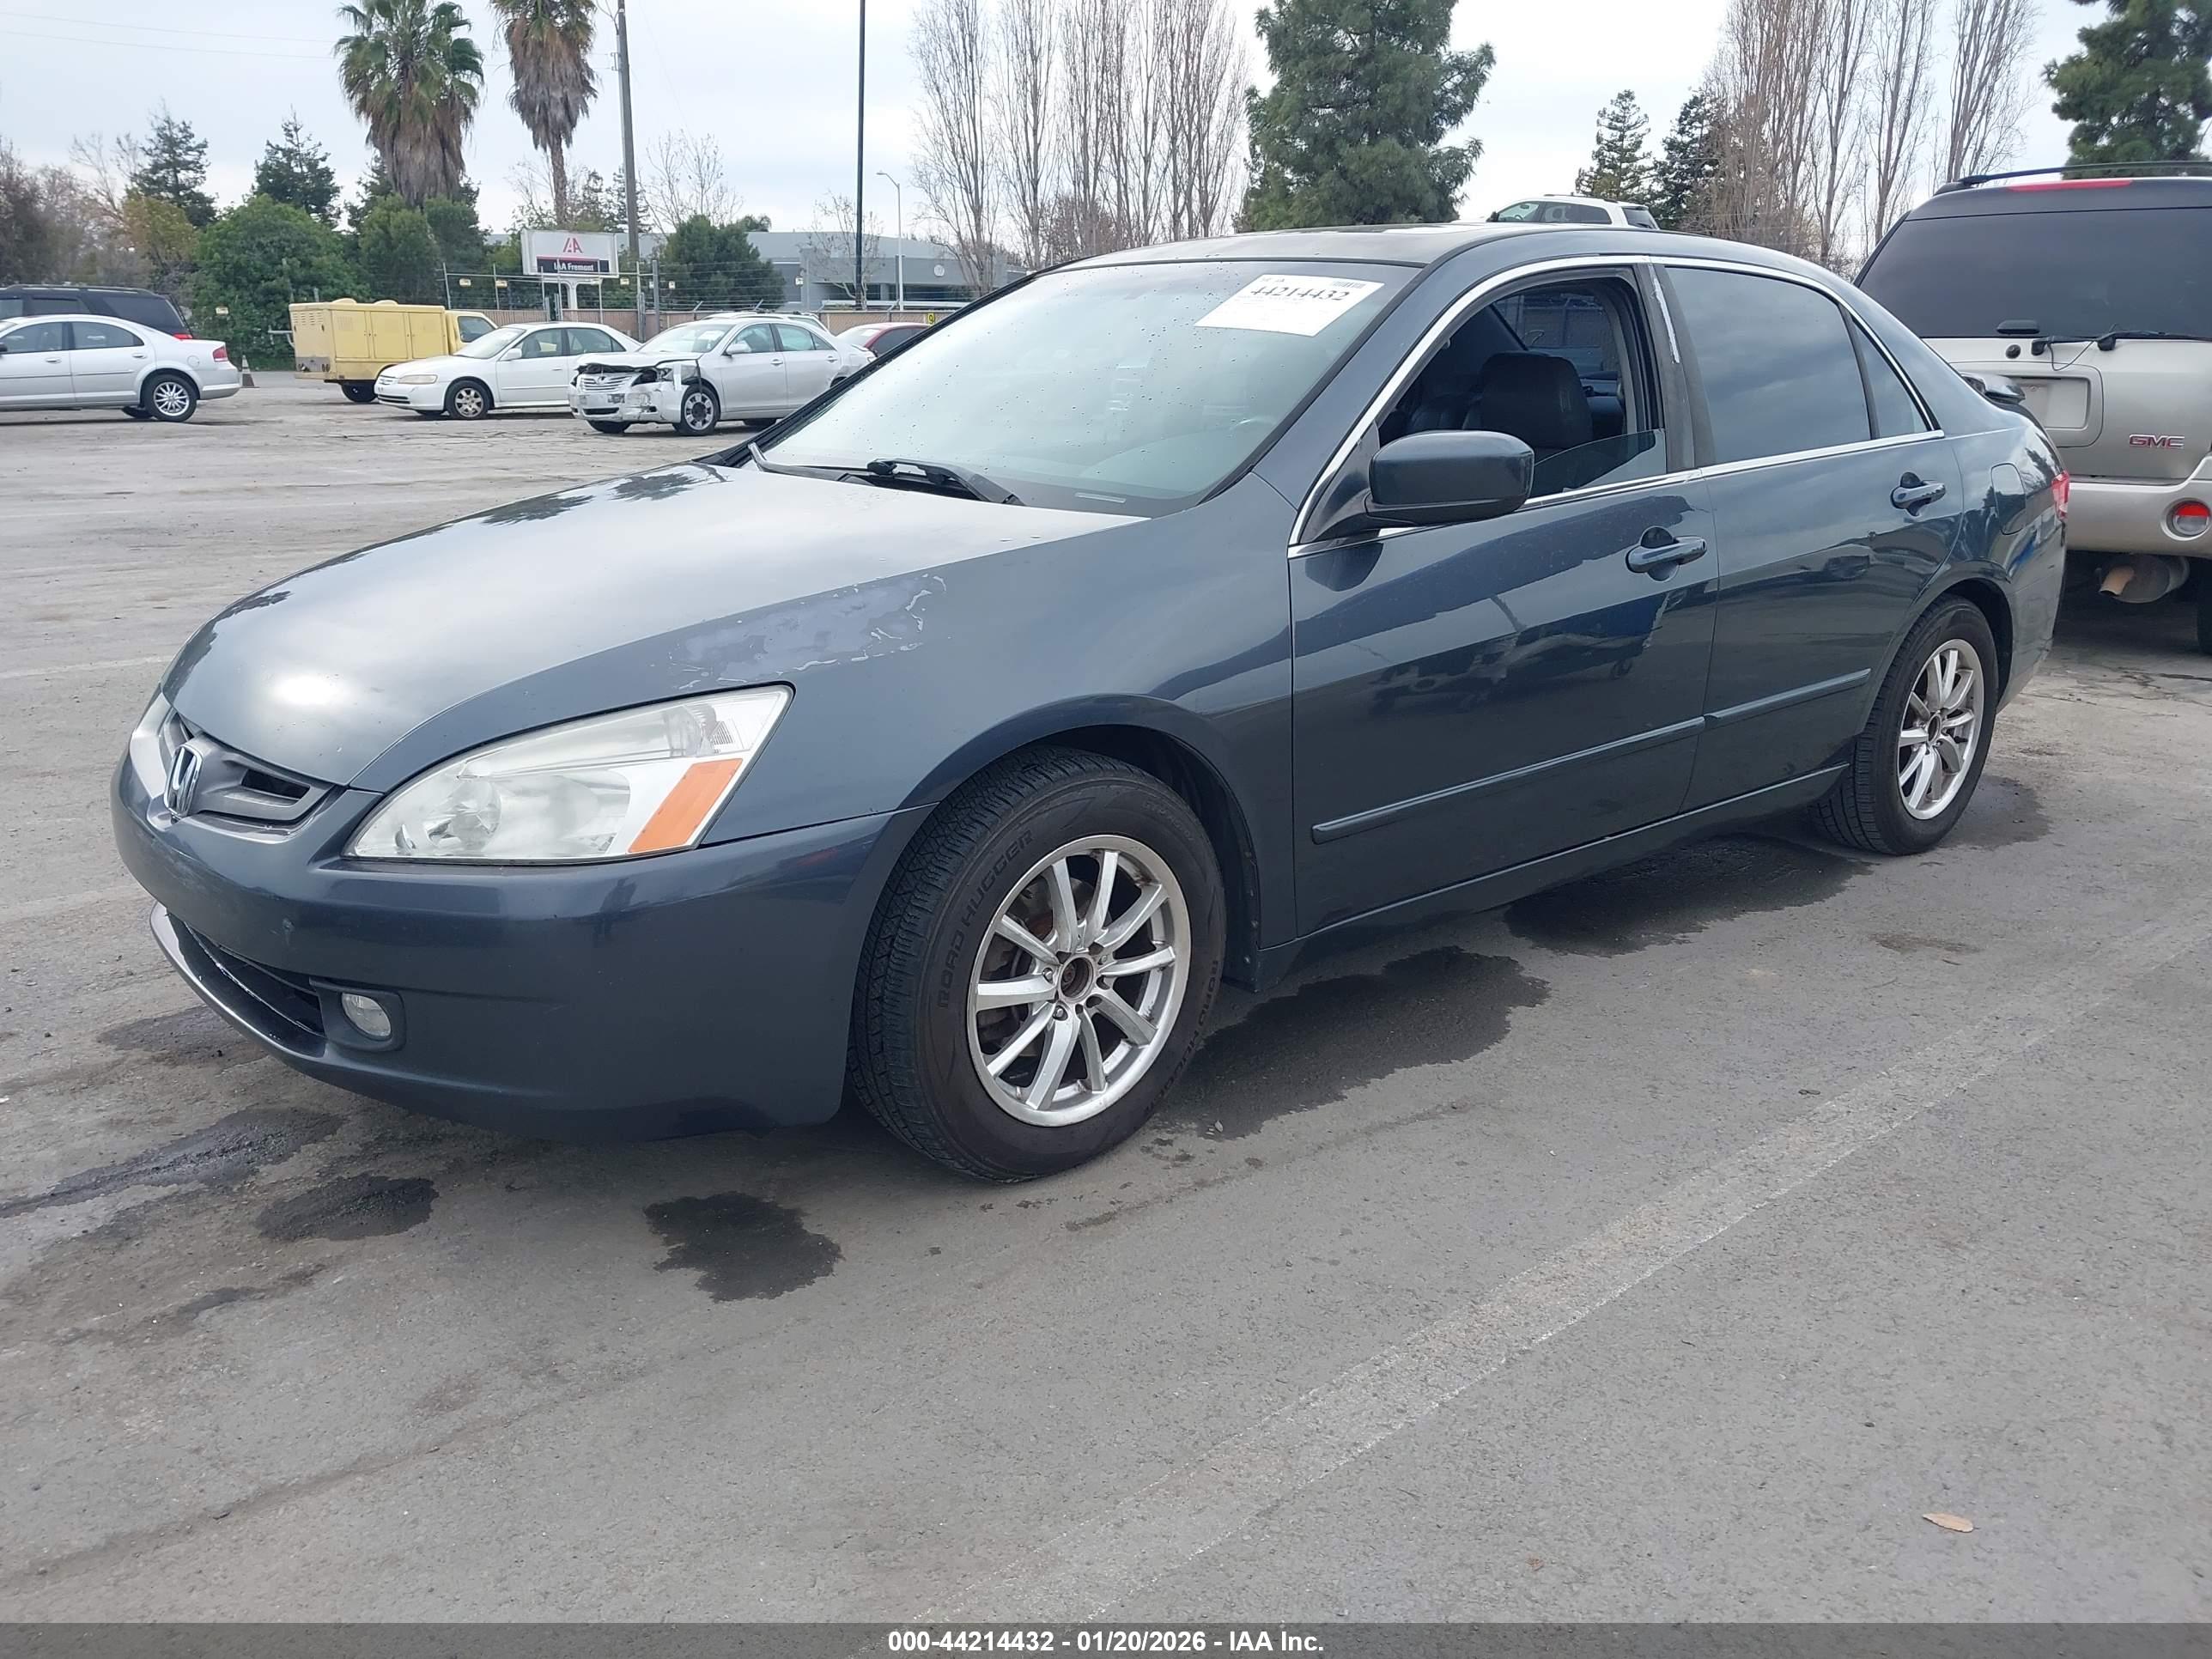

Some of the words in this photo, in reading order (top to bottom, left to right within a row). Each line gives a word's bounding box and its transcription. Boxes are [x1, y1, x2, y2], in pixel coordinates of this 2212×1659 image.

[568, 262, 594, 271] Fremont
[1250, 286, 1350, 301] 44214432
[2130, 434, 2185, 448] GMC
[961, 829, 1034, 927] HUGGER
